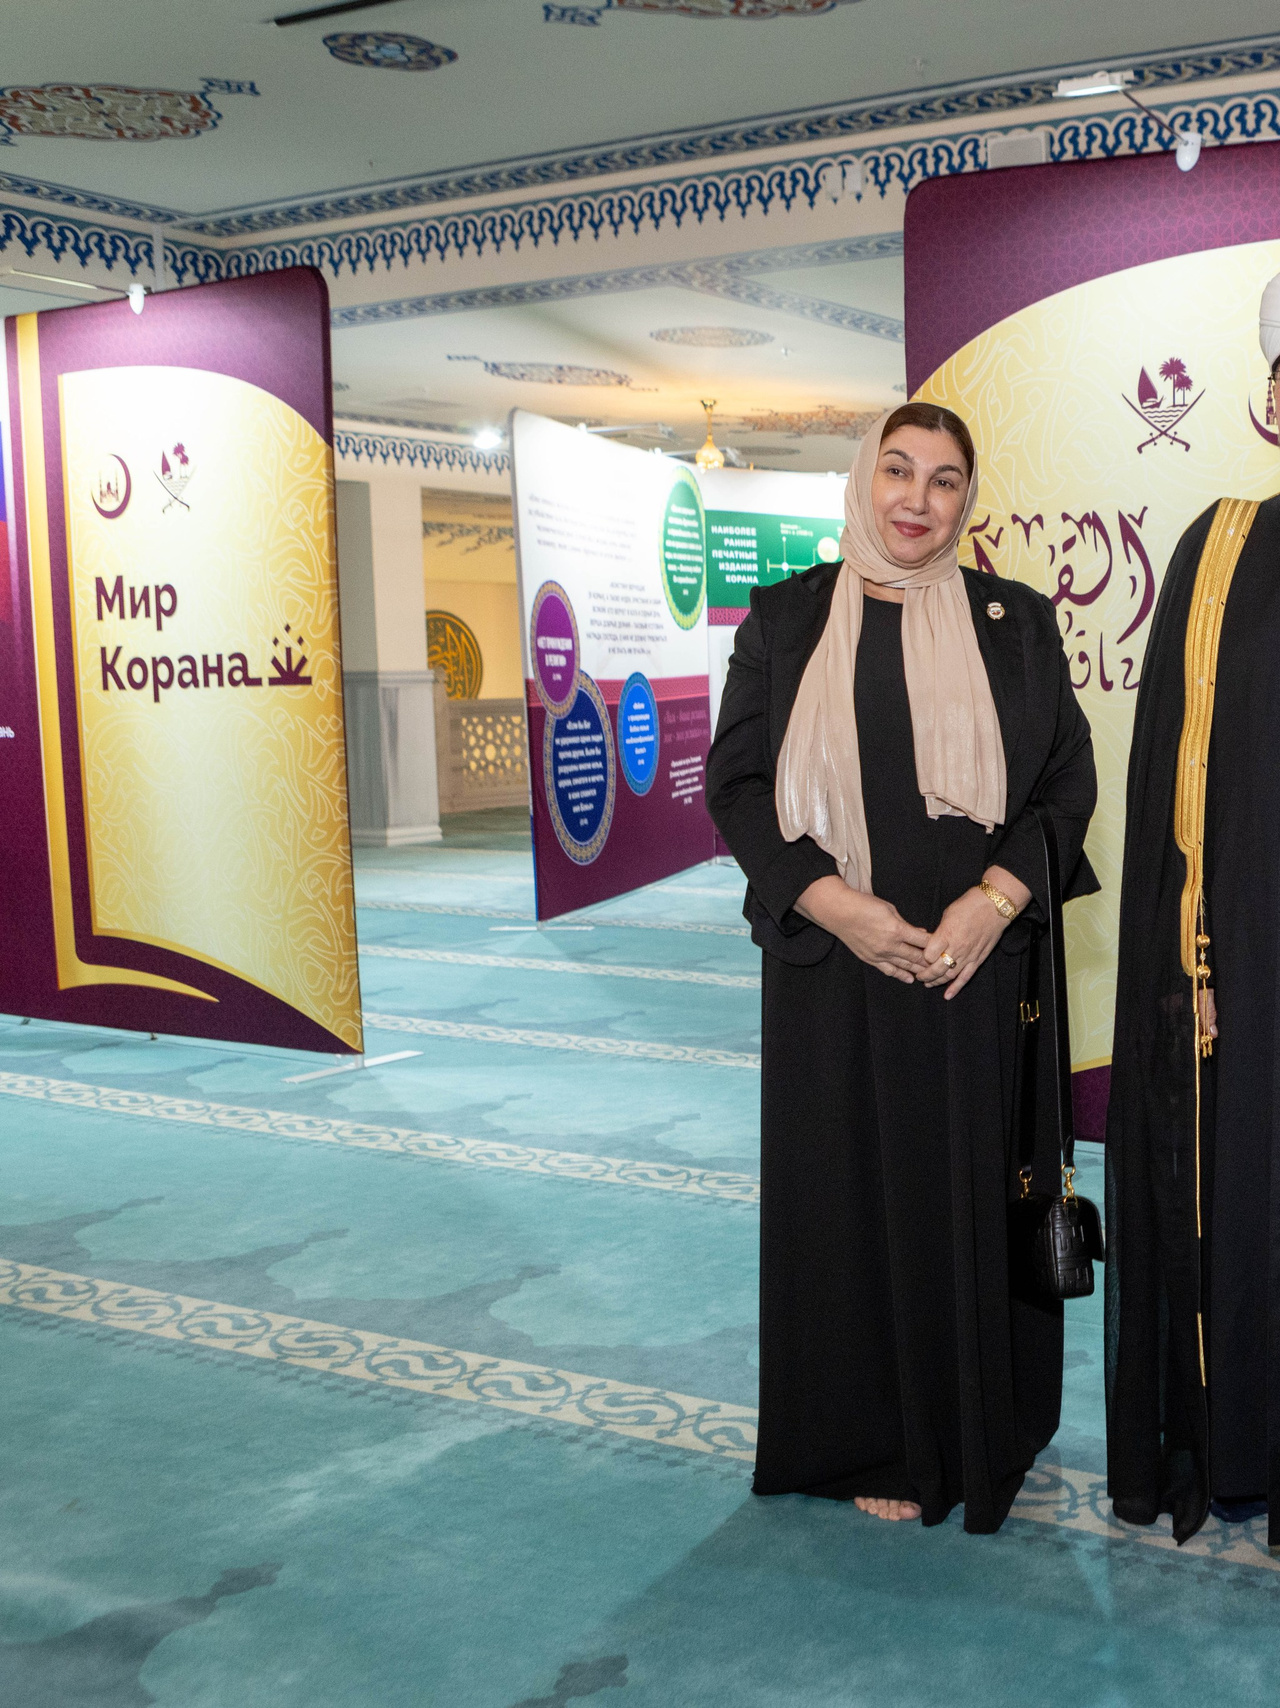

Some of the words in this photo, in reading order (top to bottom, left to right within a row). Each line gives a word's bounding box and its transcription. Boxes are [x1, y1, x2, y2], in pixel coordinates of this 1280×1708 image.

[711, 525, 757, 537] НАИБОЛЕЕ
[724, 537, 757, 549] РАННИЕ
[712, 549, 758, 561] ПЕЧАТНЫЕ
[718, 562, 759, 573] ИЗДАНИЯ
[725, 574, 759, 585] КОРАНА
[95, 575, 178, 631] Мир
[100, 646, 262, 703] Корана
